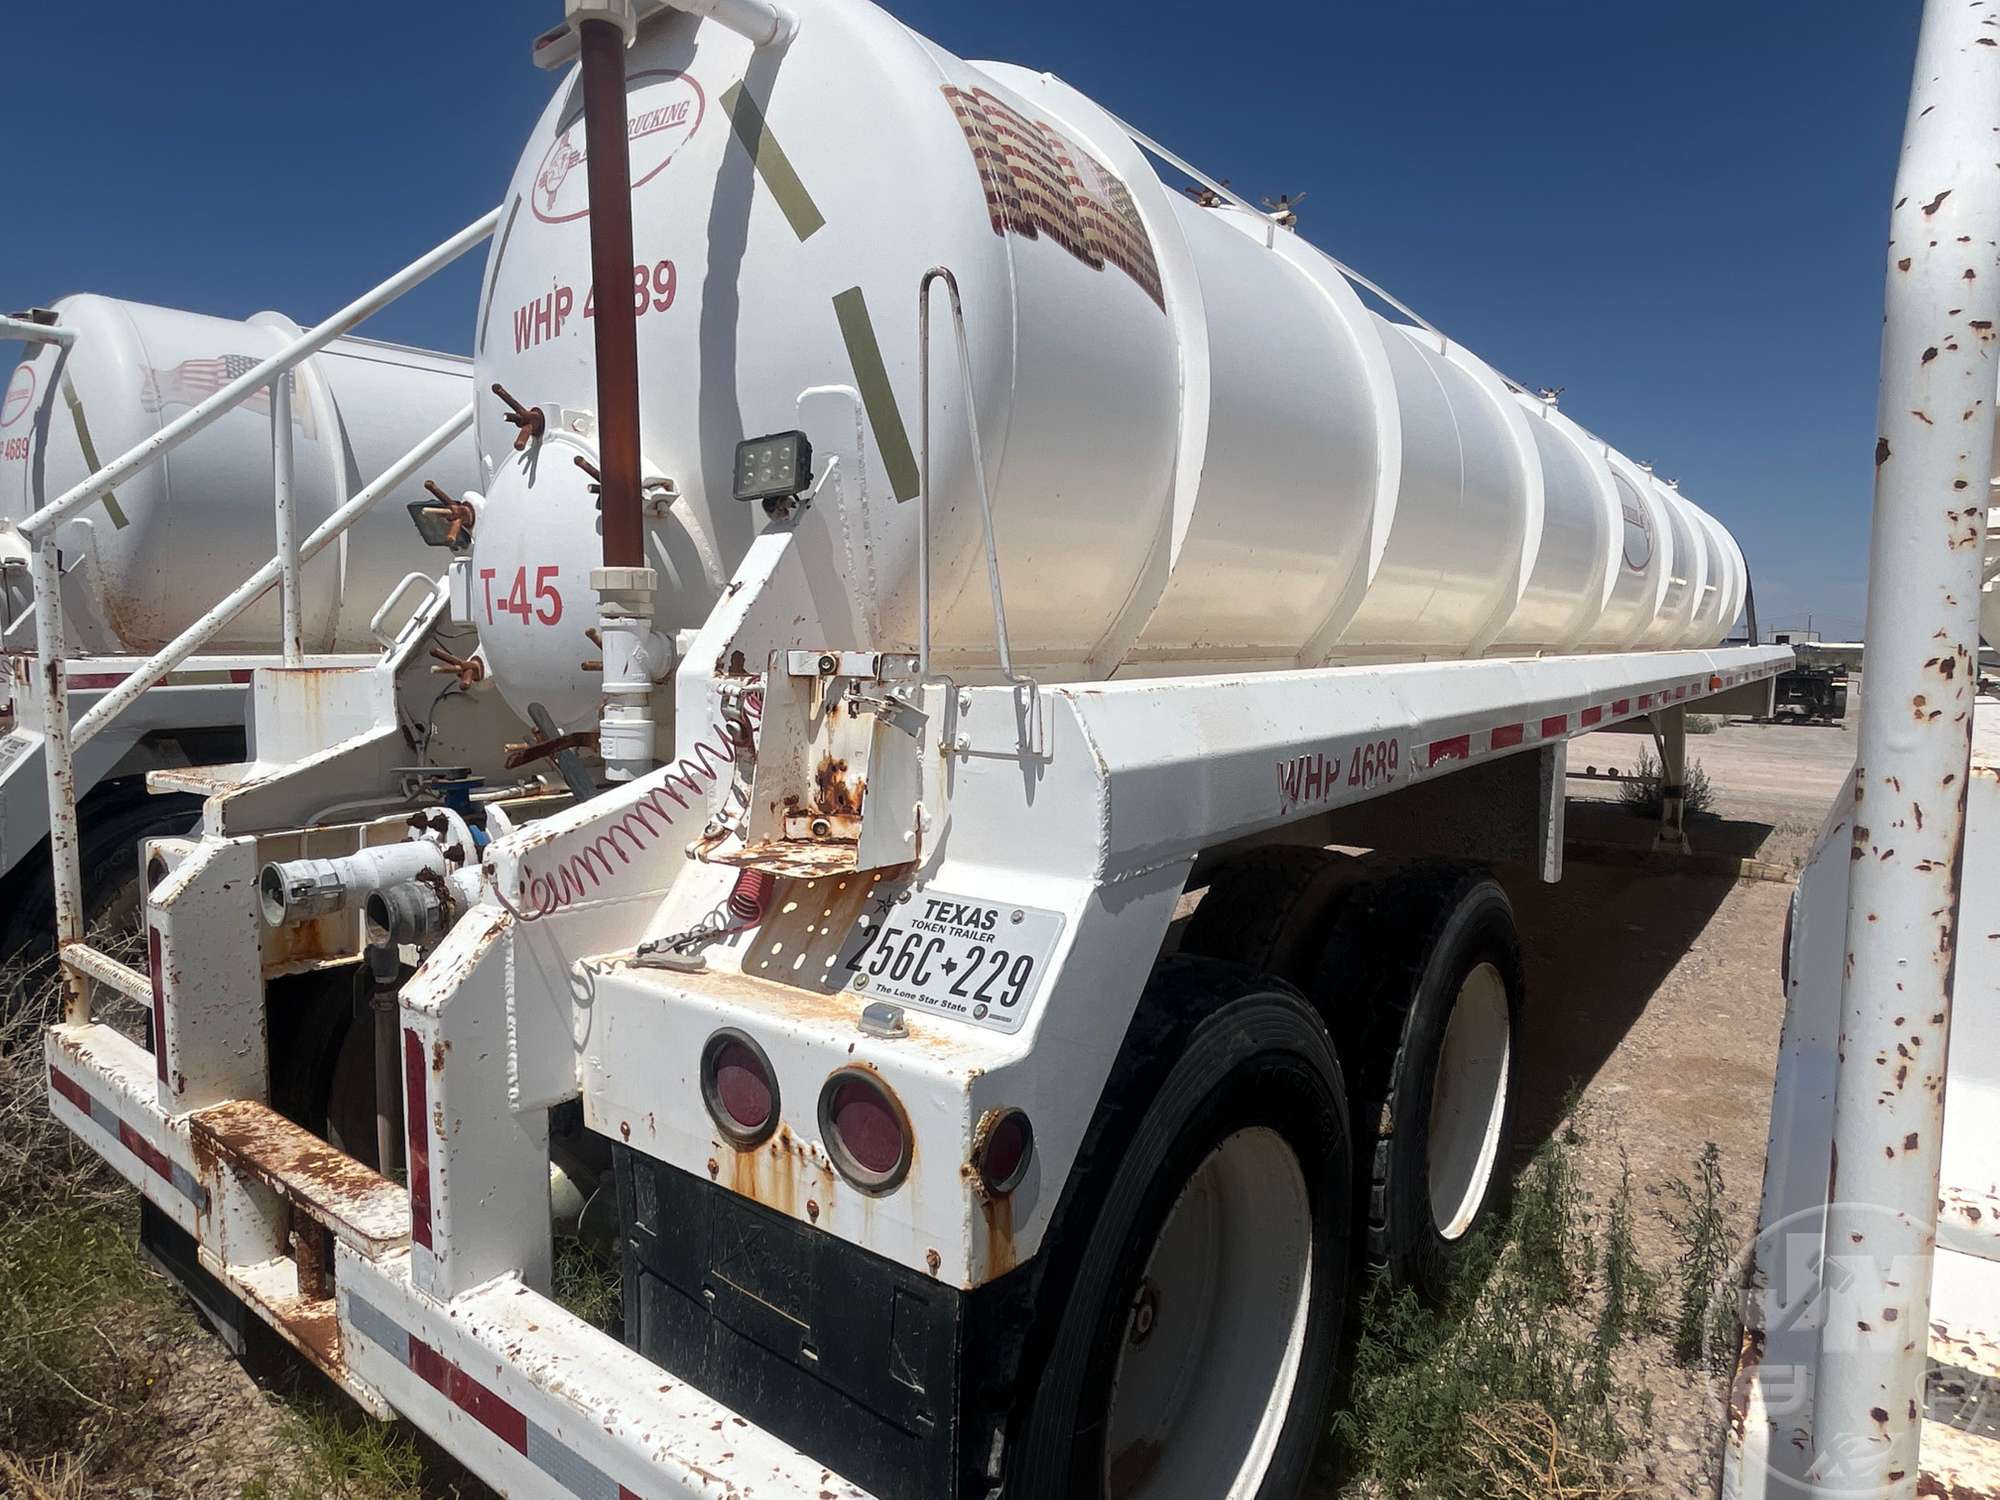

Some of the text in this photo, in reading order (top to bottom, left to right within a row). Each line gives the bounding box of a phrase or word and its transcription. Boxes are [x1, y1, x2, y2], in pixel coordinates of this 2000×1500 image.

[627, 100, 690, 135] RUCKING
[513, 286, 574, 354] WHP
[480, 566, 563, 626] T-45
[1277, 738, 1398, 816] WHP 4689
[911, 919, 996, 944] TOKEN TRAILER
[923, 899, 999, 931] TEXAS
[845, 924, 1035, 1008] 256C 229
[875, 983, 967, 1013] The Lone Star State
